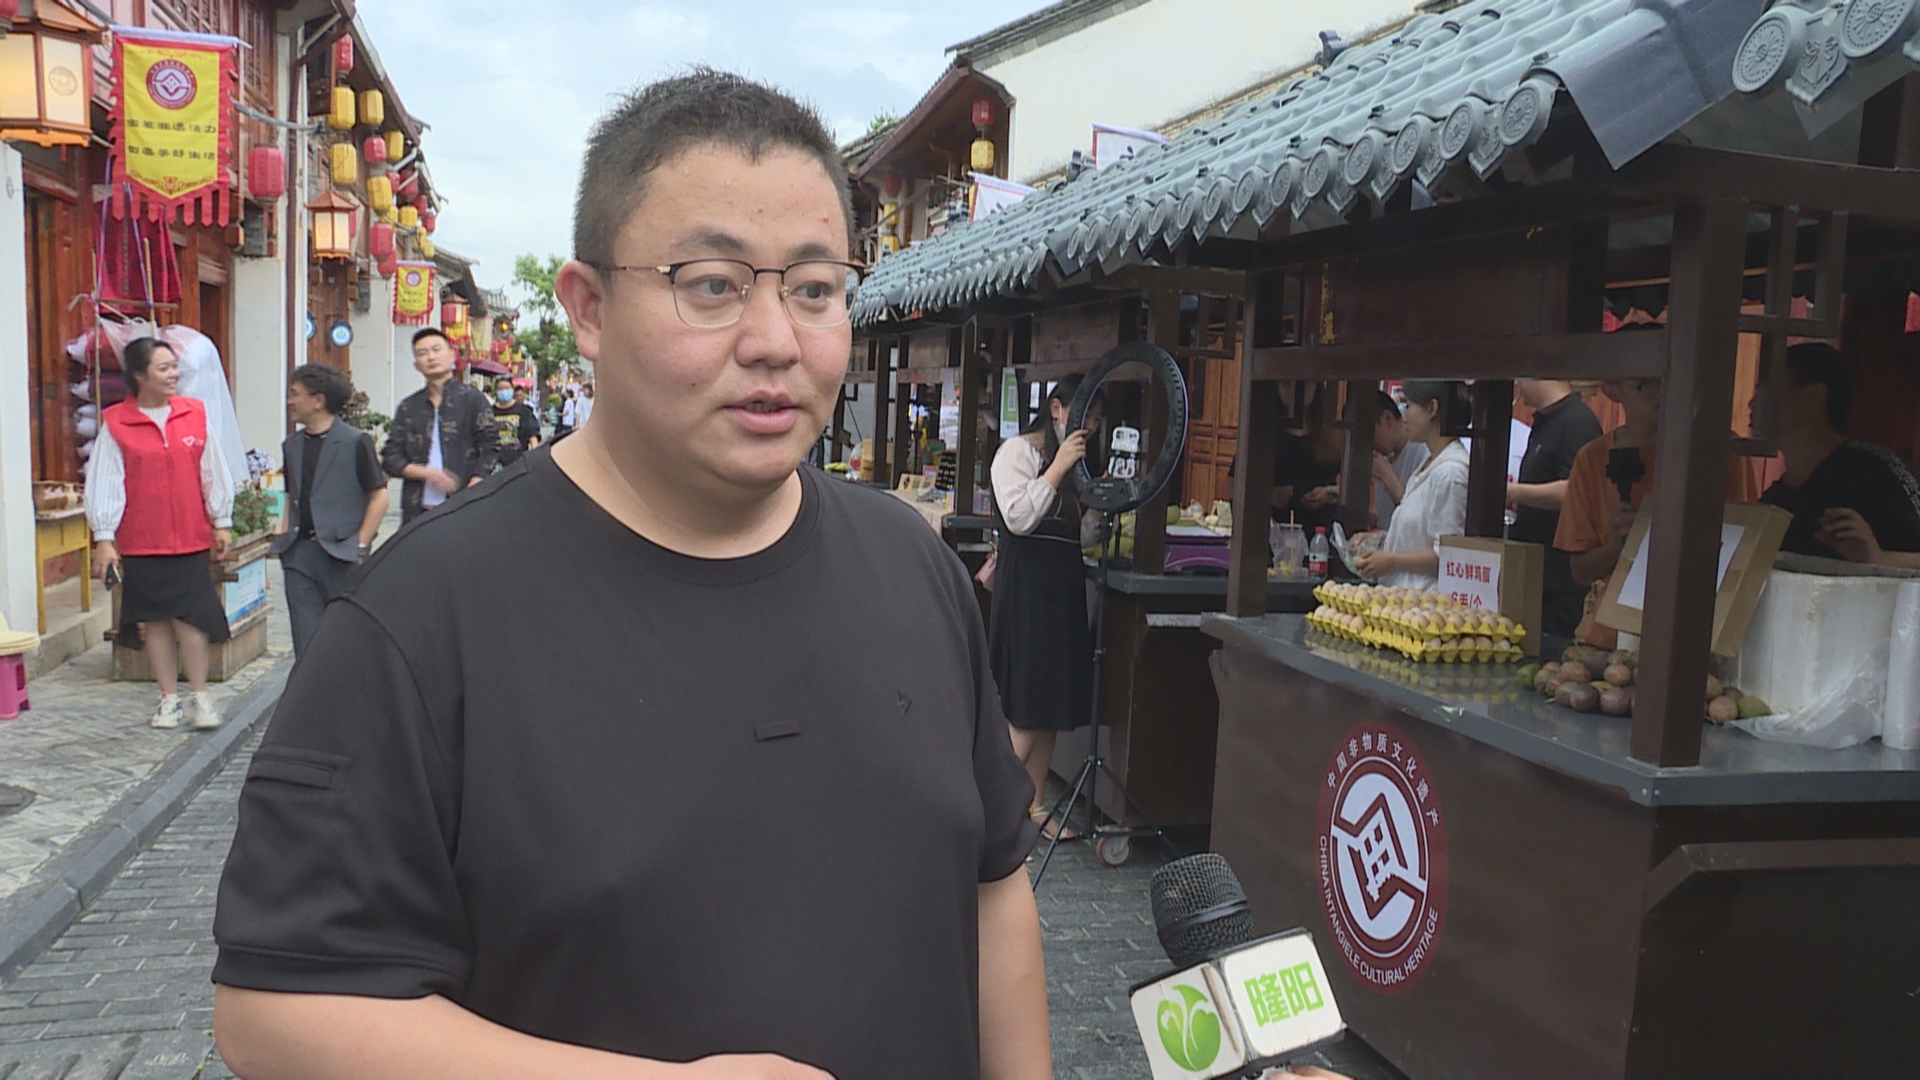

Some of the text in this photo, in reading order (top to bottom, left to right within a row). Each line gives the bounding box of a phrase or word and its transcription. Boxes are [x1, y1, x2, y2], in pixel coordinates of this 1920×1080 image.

[1328, 732, 1438, 827] 中国非物质文化遗产
[1320, 835, 1329, 887] CHINA
[1360, 962, 1406, 985] CULTURAL
[1404, 906, 1438, 976] HERITAGE
[1243, 961, 1324, 1027] 隆阳
